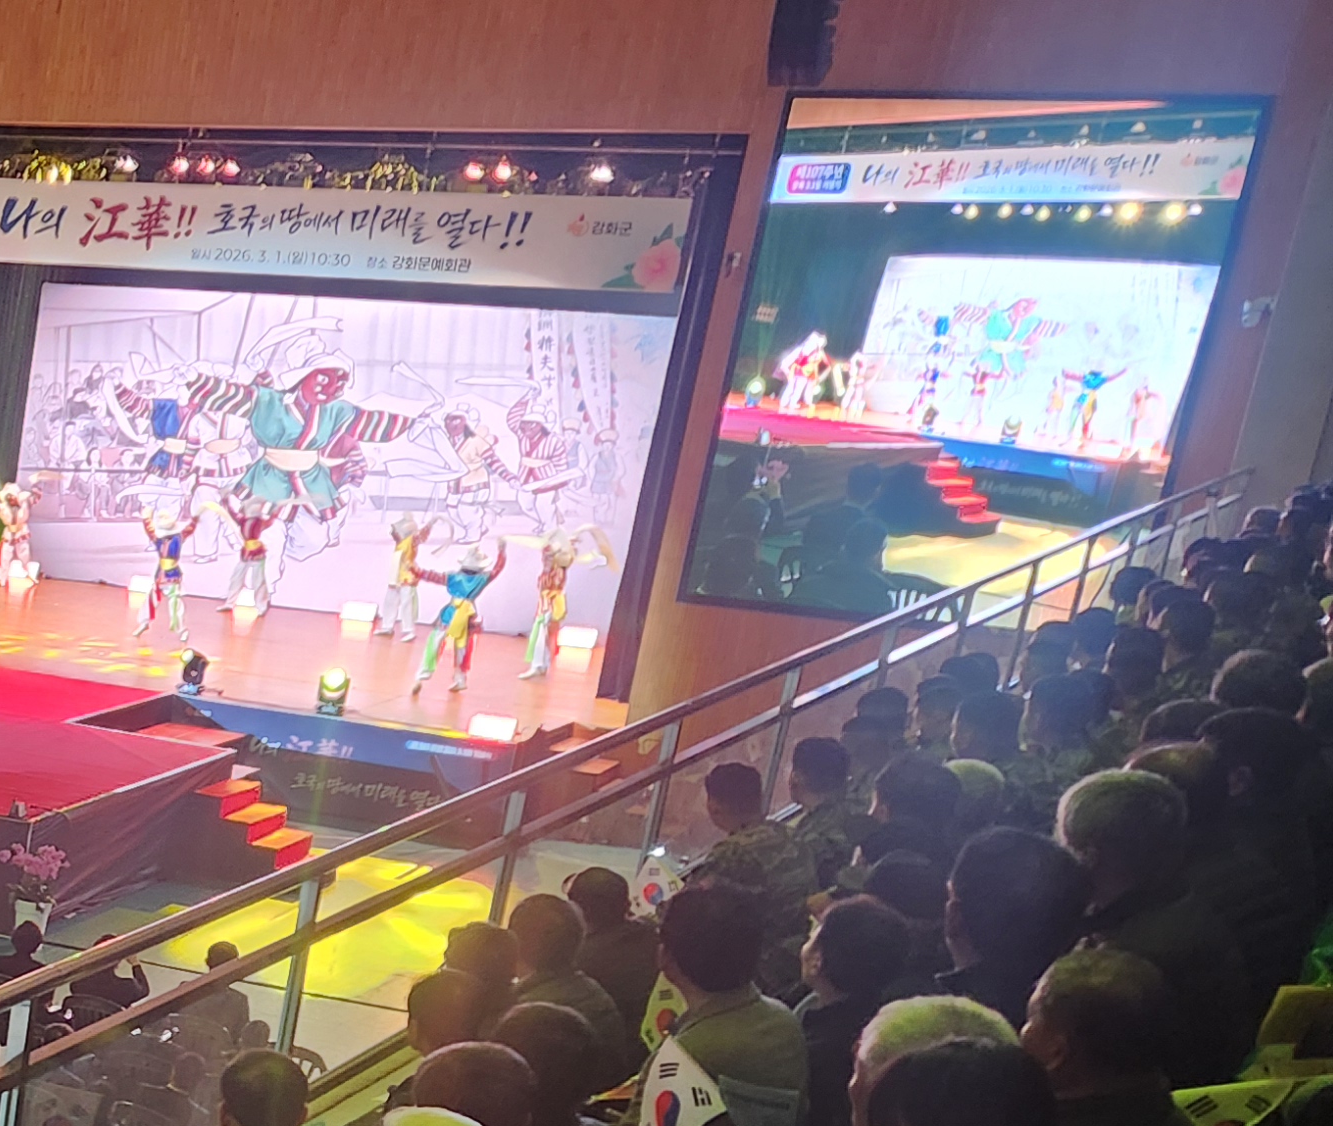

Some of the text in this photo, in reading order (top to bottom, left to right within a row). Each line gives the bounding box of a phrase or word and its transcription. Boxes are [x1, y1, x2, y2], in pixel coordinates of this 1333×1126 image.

[0, 195, 533, 251] 나의 江華!! 호국의 땅에서 미래를 열다!!
